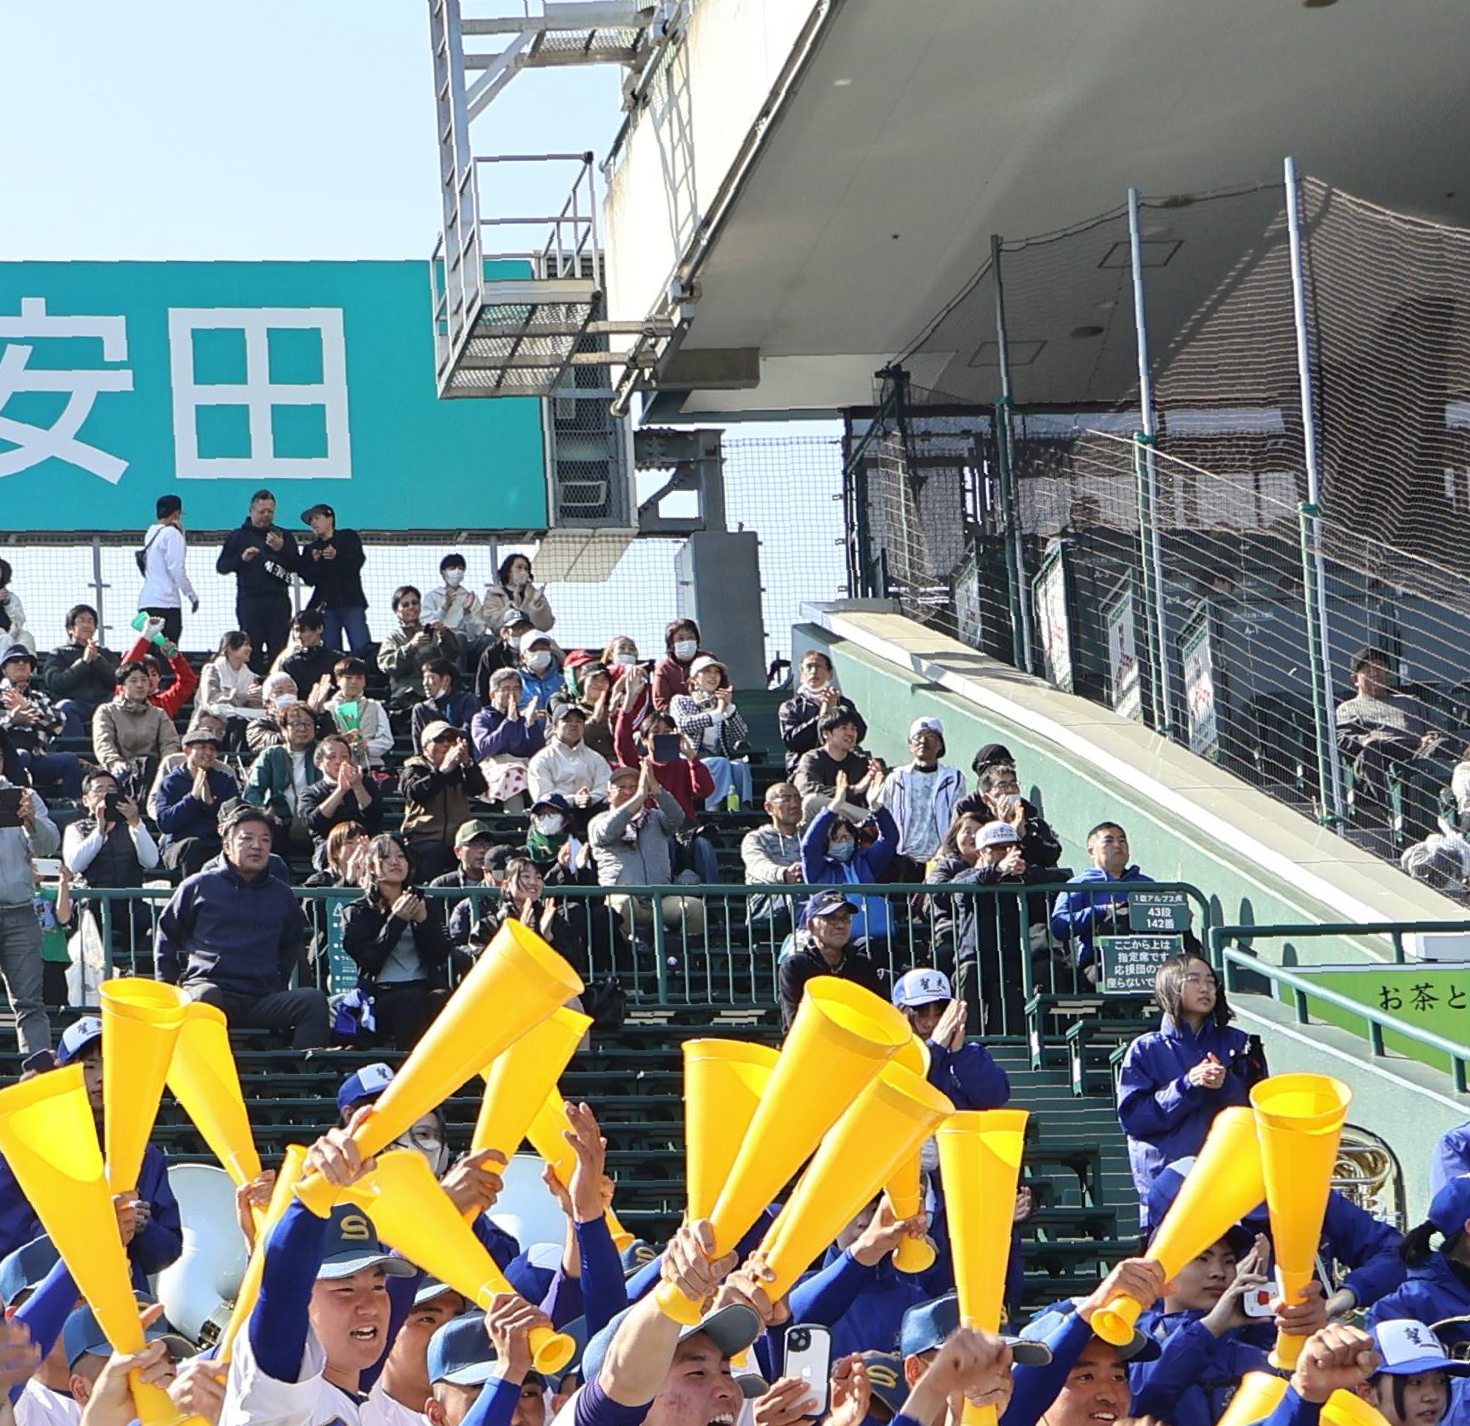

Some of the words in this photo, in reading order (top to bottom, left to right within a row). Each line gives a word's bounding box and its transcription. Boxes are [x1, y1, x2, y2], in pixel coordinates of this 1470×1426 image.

[1114, 940, 1171, 950] ここから上は
[1117, 952, 1170, 963] 指定席です
[1379, 982, 1467, 1012] お茶と
[340, 1215, 370, 1241] S
[867, 1365, 899, 1389] S
